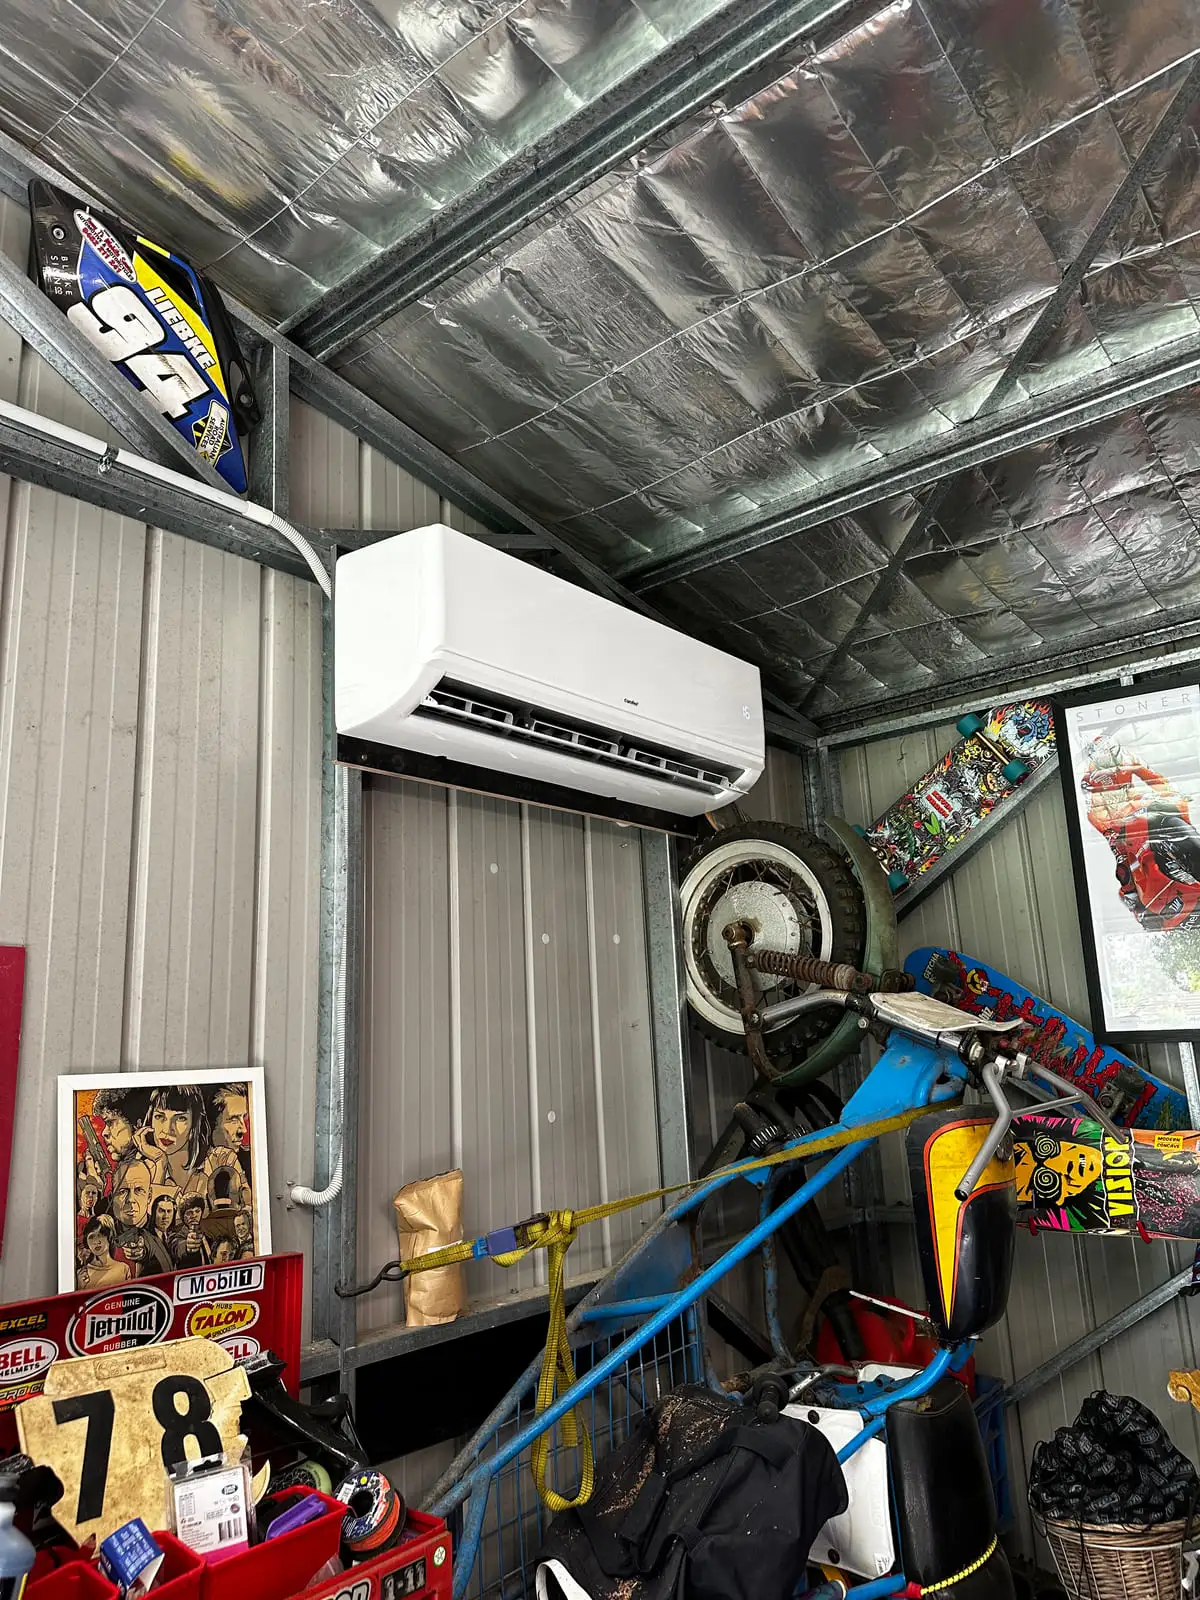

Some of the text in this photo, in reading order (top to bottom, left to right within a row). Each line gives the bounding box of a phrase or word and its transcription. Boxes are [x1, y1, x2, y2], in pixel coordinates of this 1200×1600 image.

[76, 213, 103, 243] AUTOMOTIVE
[106, 247, 134, 281] MOTORCYCLES
[60, 256, 73, 296] BLKE
[144, 286, 217, 369] LIEBKE
[201, 417, 216, 449] SERVICES
[208, 425, 220, 446] ROAD
[209, 418, 225, 459] AUSTRALIAN
[1076, 693, 1190, 722] STONER
[1103, 1135, 1134, 1217] VISION
[104, 1298, 141, 1311] GENUINE
[0, 1314, 46, 1331] EXCEL
[195, 1309, 248, 1330] TALON
[0, 1345, 46, 1370] BELL
[103, 1338, 137, 1352] RUBBER
